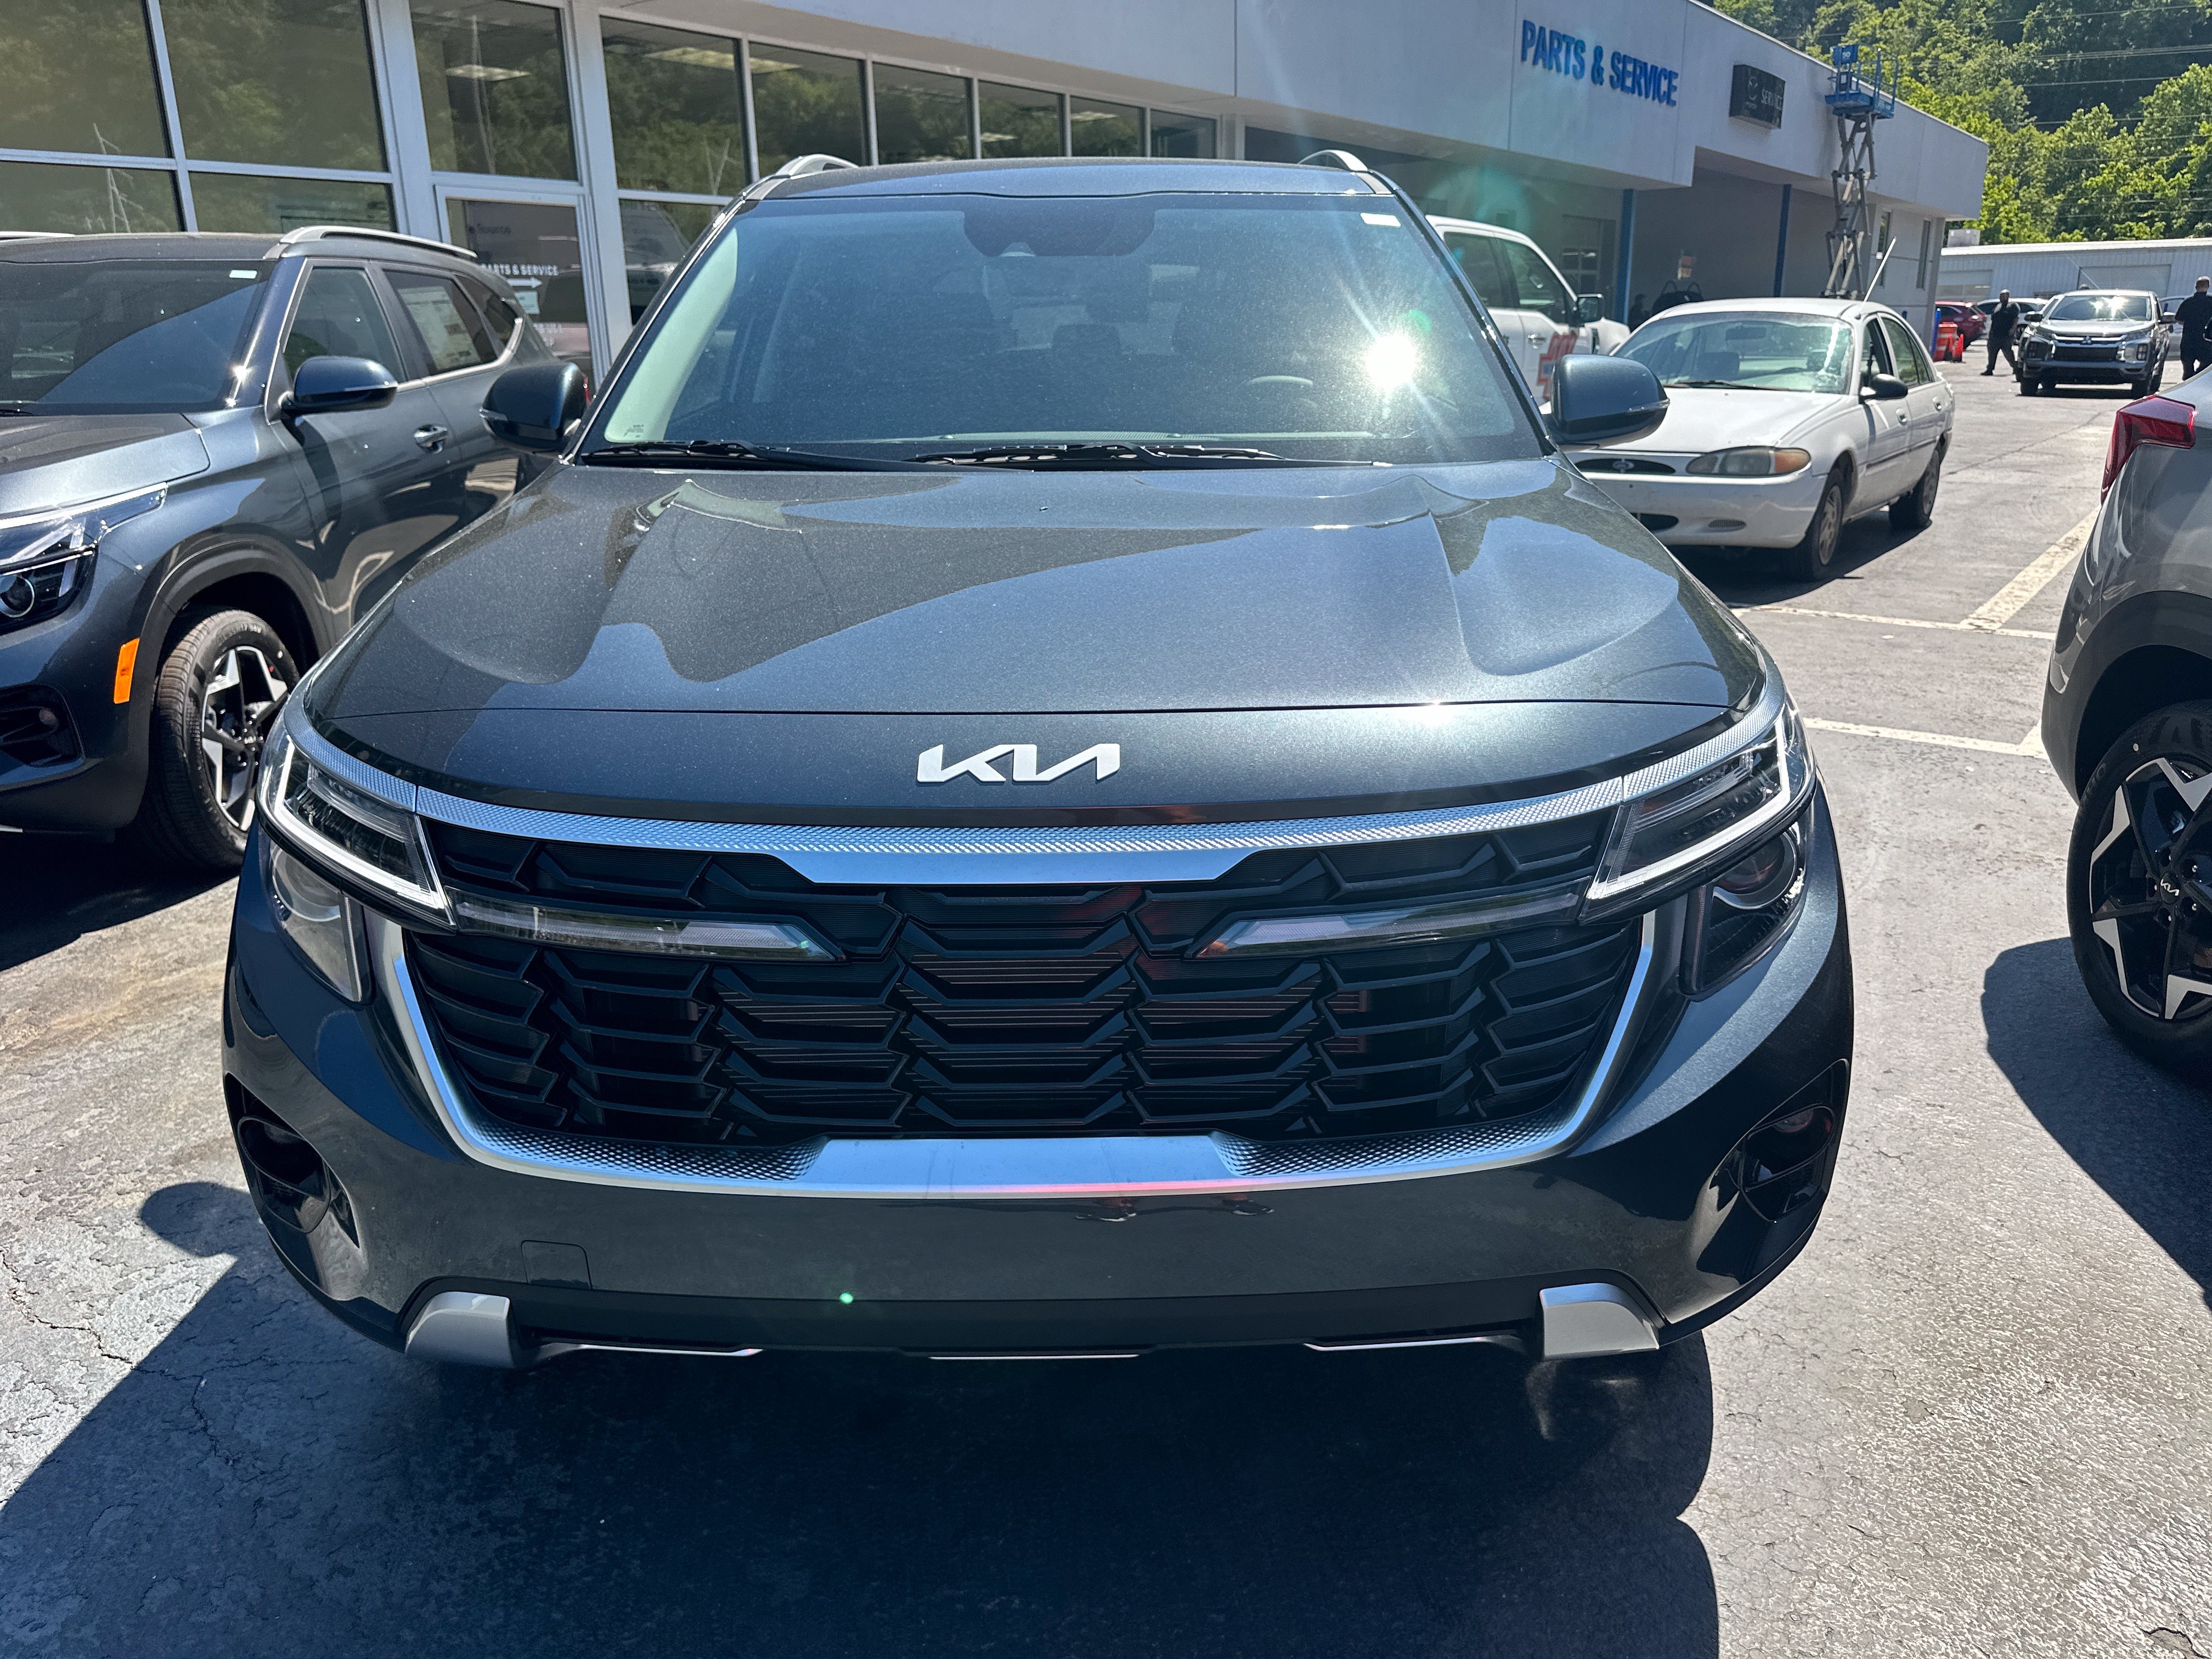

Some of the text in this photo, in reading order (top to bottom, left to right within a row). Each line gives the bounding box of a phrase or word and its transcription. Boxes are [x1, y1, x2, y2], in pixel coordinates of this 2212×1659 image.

[1521, 20, 1679, 106] PARTS & SERVICE
[512, 263, 520, 275] &
[520, 263, 559, 276] SERVICE
[917, 743, 1120, 783] KIA
[2160, 879, 2180, 896] KIA
